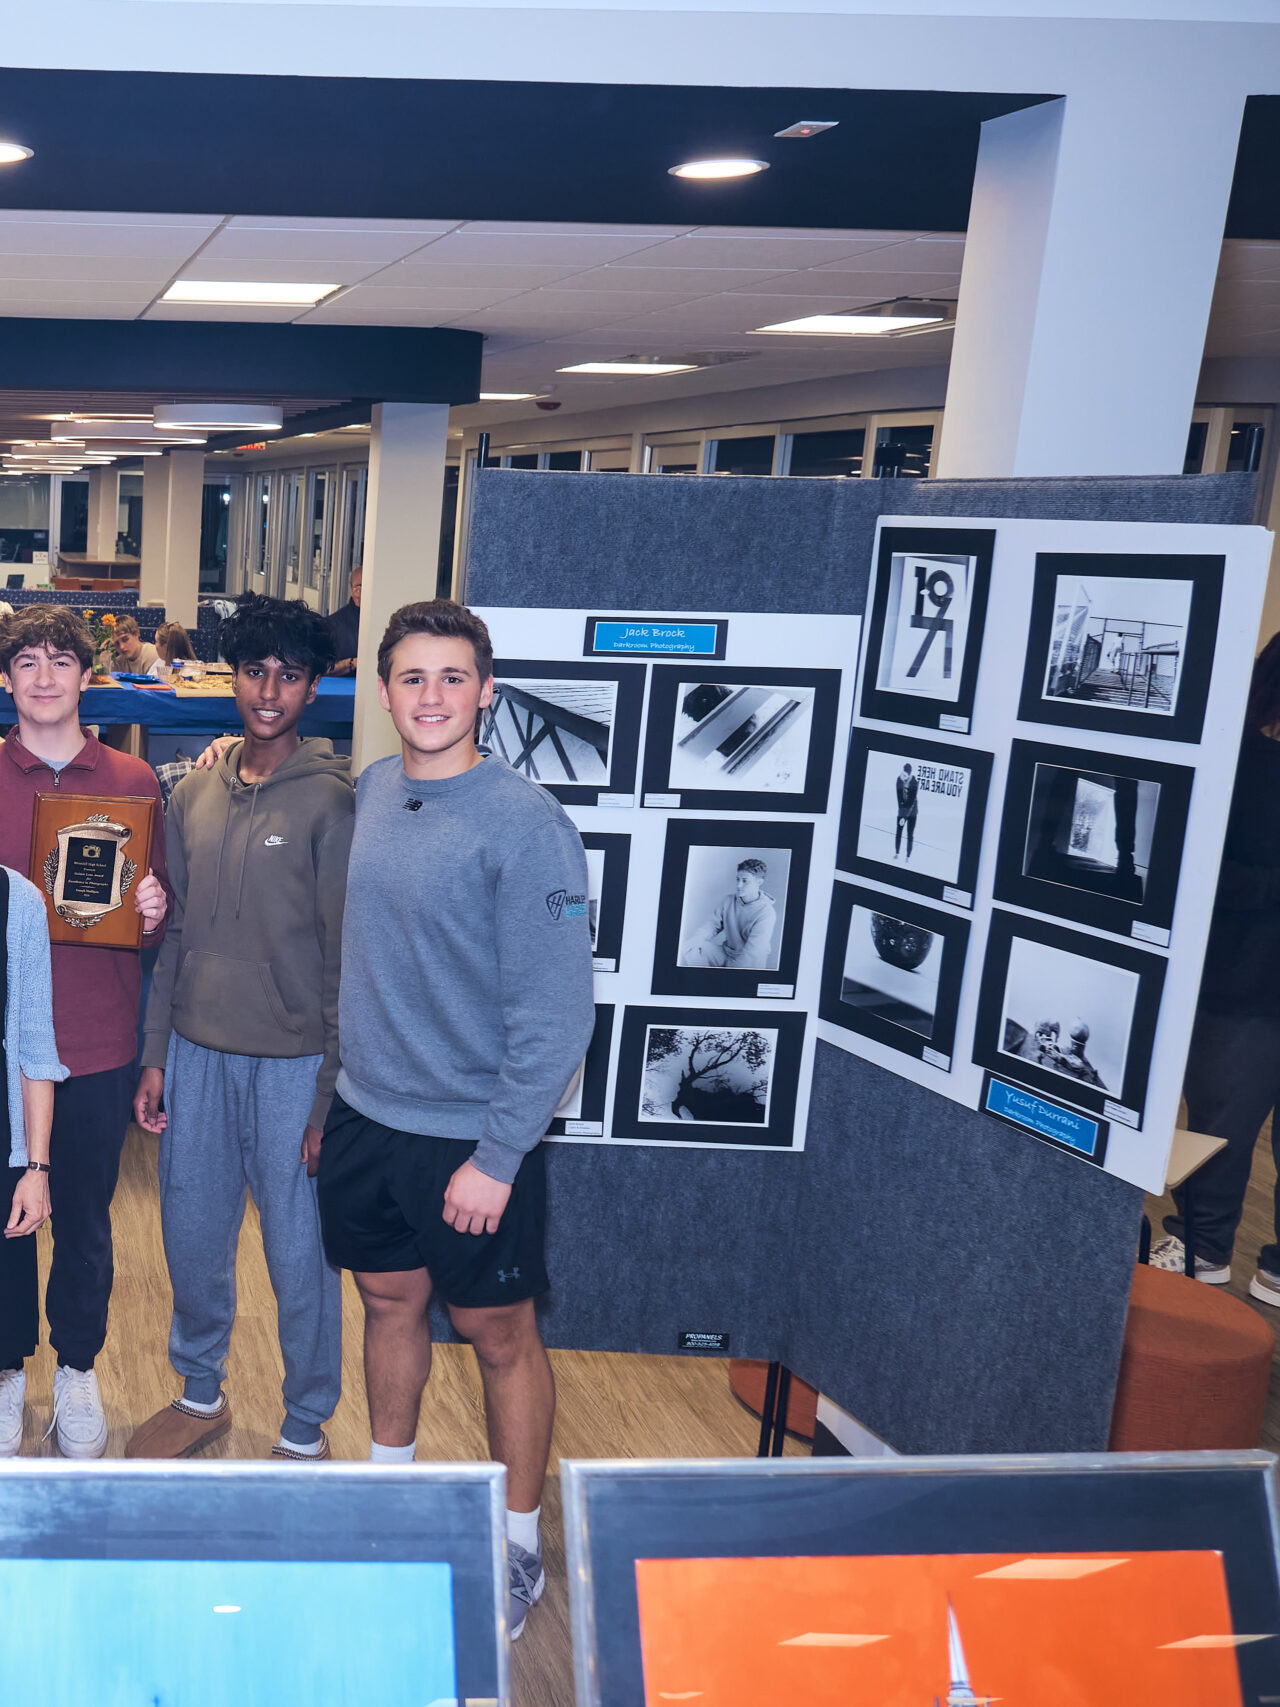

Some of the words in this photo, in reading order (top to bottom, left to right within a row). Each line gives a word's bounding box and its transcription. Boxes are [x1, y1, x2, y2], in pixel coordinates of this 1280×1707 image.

[619, 627, 649, 639] Jack
[651, 628, 686, 638] Brock
[613, 641, 648, 649] Darkroom
[650, 642, 695, 652] Photography
[1005, 1090, 1039, 1114] Yusuf
[1038, 1105, 1080, 1130] Durrani
